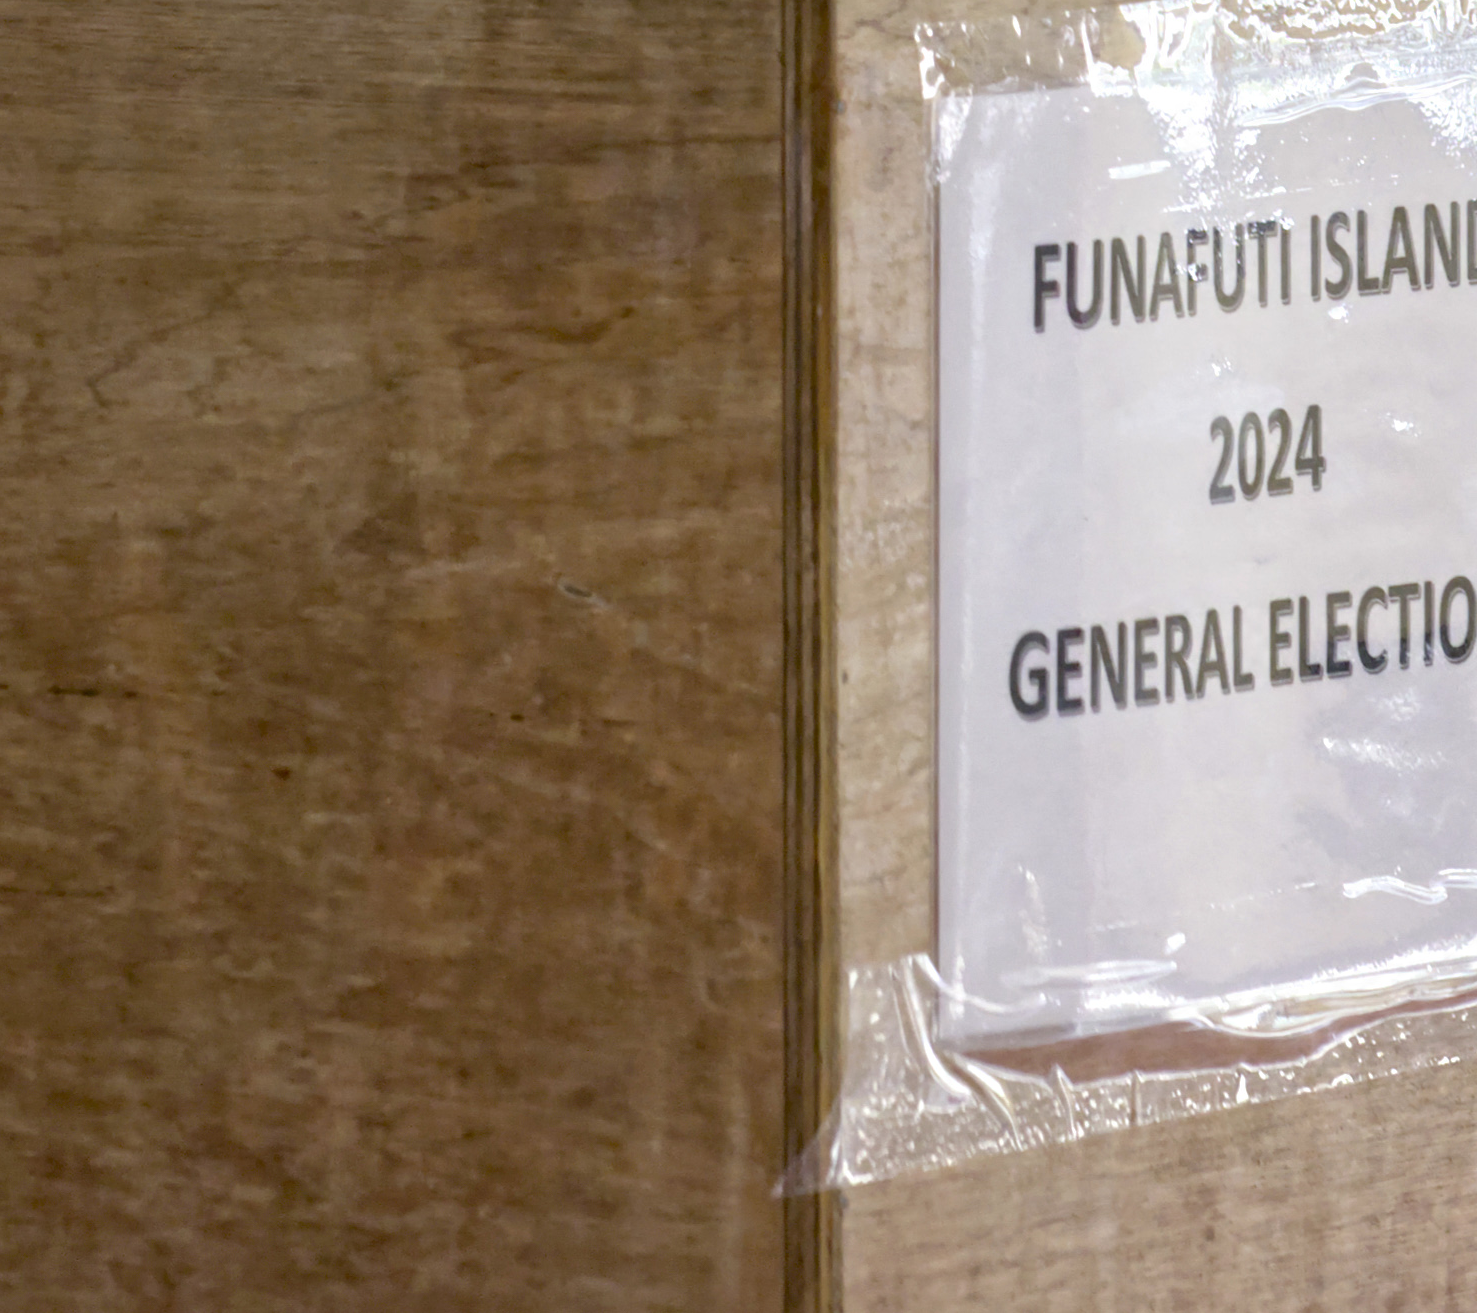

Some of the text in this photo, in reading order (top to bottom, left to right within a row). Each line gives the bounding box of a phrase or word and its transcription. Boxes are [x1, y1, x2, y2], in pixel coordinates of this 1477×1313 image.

[1034, 221, 1291, 333] FUNAFUTI
[1208, 403, 1326, 504] 2024
[1008, 604, 1255, 721] GENERAL
